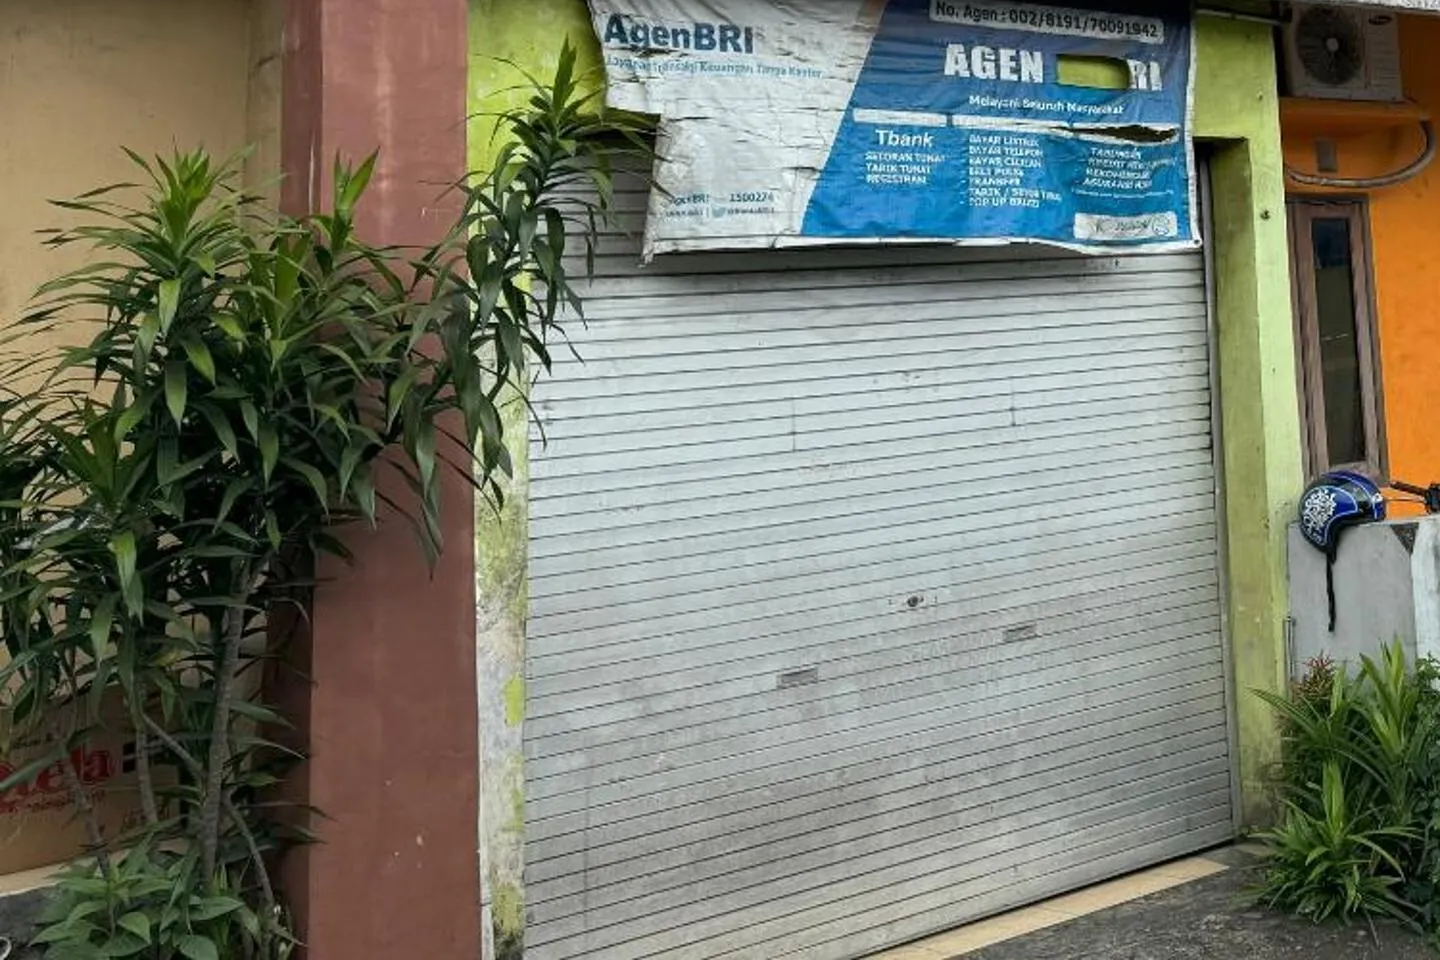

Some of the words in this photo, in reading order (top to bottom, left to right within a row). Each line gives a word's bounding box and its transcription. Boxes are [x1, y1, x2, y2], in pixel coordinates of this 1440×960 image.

[936, 0, 959, 19] No.
[604, 12, 754, 55] AgenBRI
[944, 42, 1044, 84] AGEN
[1126, 58, 1163, 91] RI
[875, 129, 935, 148] Tbank
